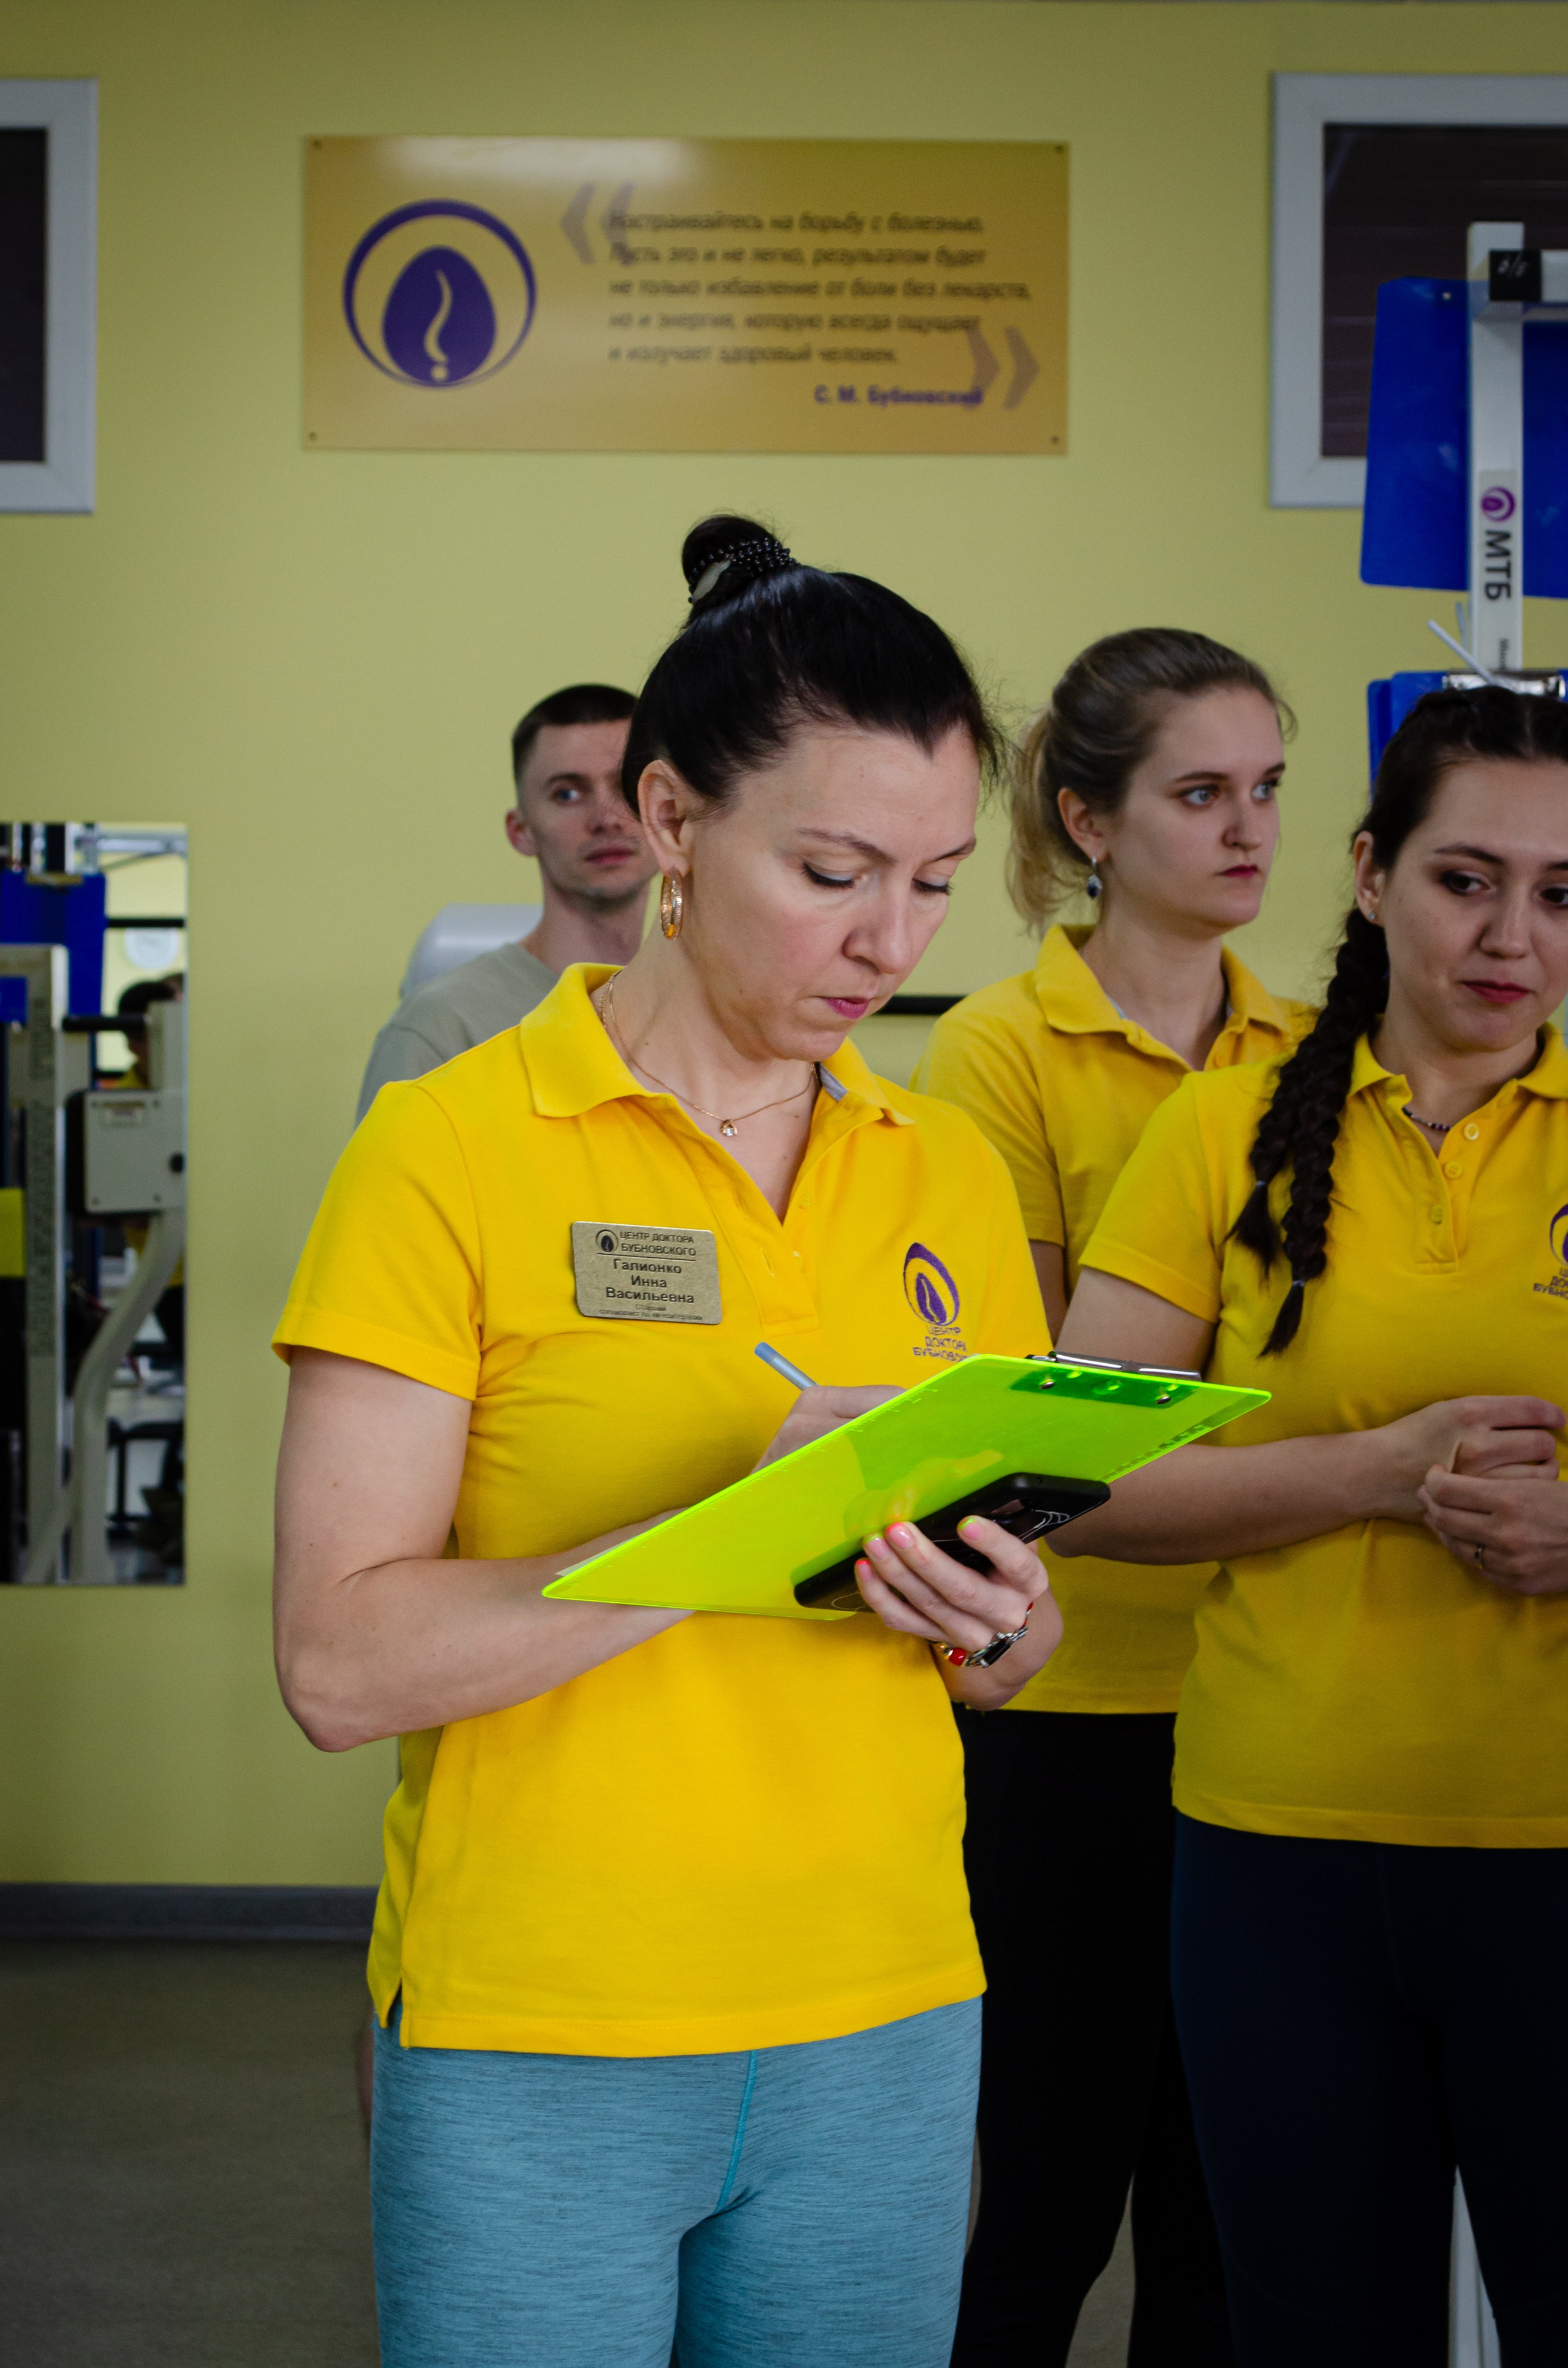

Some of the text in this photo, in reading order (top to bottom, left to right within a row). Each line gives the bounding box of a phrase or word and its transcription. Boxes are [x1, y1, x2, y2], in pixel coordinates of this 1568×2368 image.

[770, 216, 793, 231] на
[799, 211, 864, 234] борьбу
[871, 216, 882, 232] с
[668, 248, 698, 262] это
[703, 248, 715, 262] и
[722, 248, 745, 262] не
[936, 245, 986, 267] будет
[610, 281, 631, 295] не
[639, 281, 700, 295] только
[707, 277, 818, 297] избавление
[826, 281, 845, 296] от
[851, 278, 896, 297] боли
[903, 278, 936, 297] без
[609, 313, 632, 328] но
[638, 313, 650, 328] и
[744, 313, 823, 333] которую
[829, 314, 891, 332] всегда
[609, 346, 621, 361] и
[626, 346, 711, 366] излучает
[720, 343, 812, 366] здоровый
[867, 384, 984, 410] Бубновский
[1485, 530, 1512, 601] МТБ
[620, 1231, 695, 1243] ЦЕНТР ДОКТОРА
[621, 1243, 696, 1256] БУБНОВСКОГО
[614, 1258, 682, 1274] Галионко
[630, 1275, 667, 1288] Инна
[606, 1287, 694, 1303] Васильевна
[926, 1325, 961, 1336] ЦЕНТР
